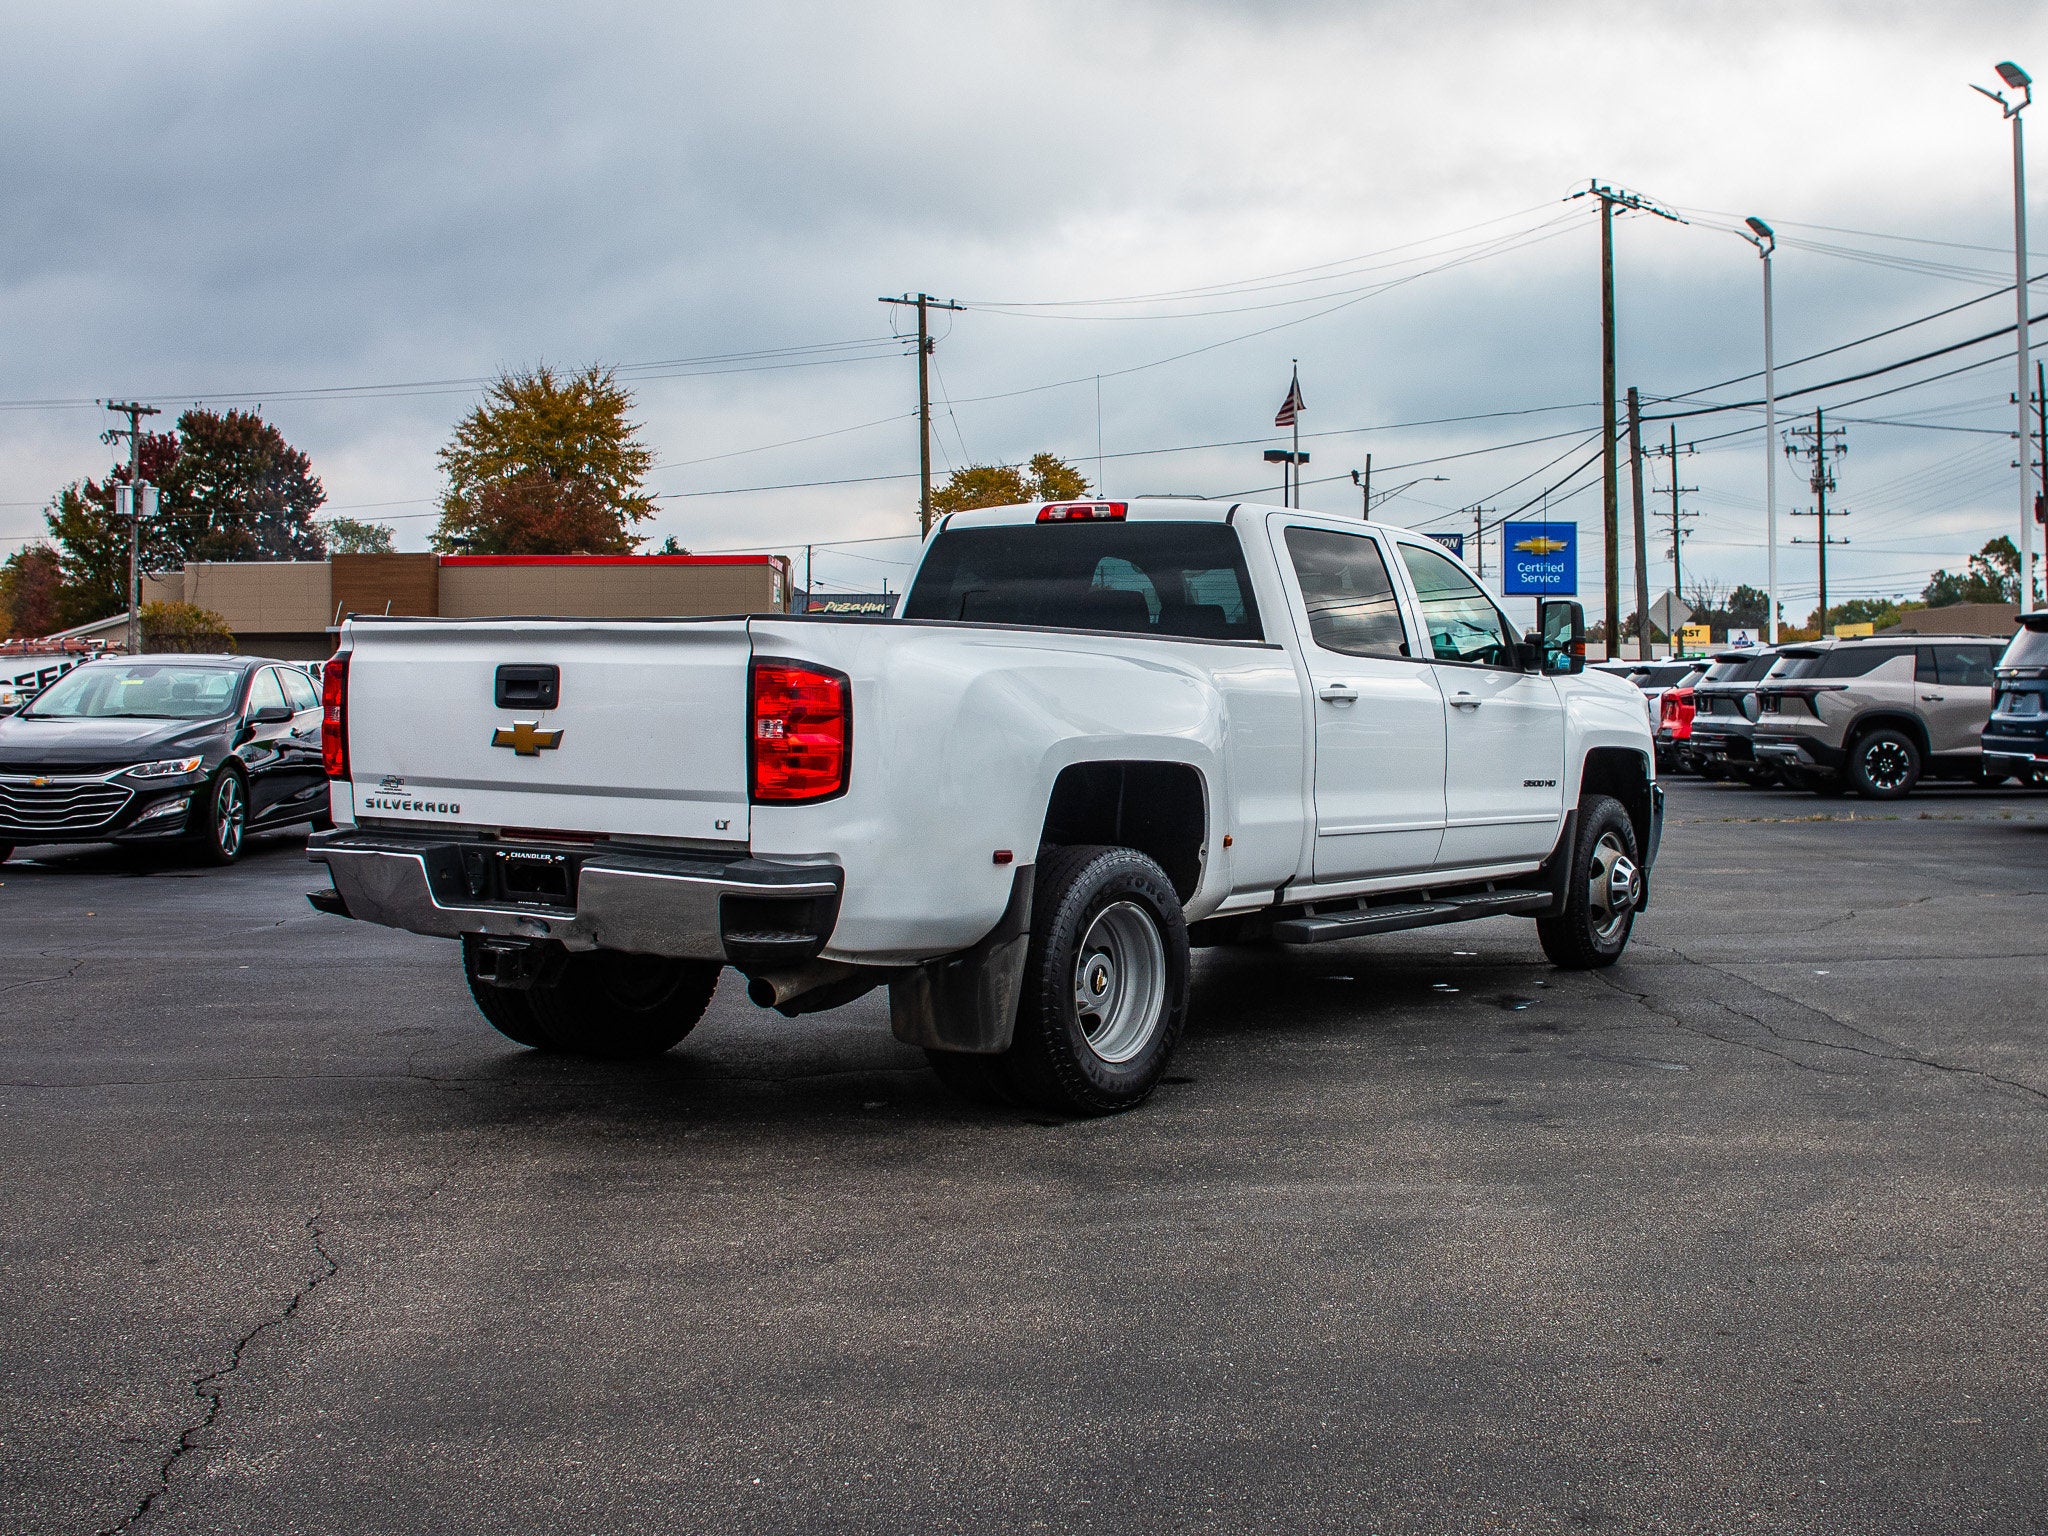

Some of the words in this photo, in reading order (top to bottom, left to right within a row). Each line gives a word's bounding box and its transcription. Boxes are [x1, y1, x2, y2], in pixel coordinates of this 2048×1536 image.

[1434, 538, 1458, 548] ON
[1517, 562, 1564, 573] Certified
[1521, 573, 1561, 583] Service
[823, 601, 861, 613] Pizza
[860, 602, 890, 614] Hut
[365, 798, 461, 813] SILVERADO
[715, 819, 731, 830] LT
[510, 852, 551, 860] CHANDLER
